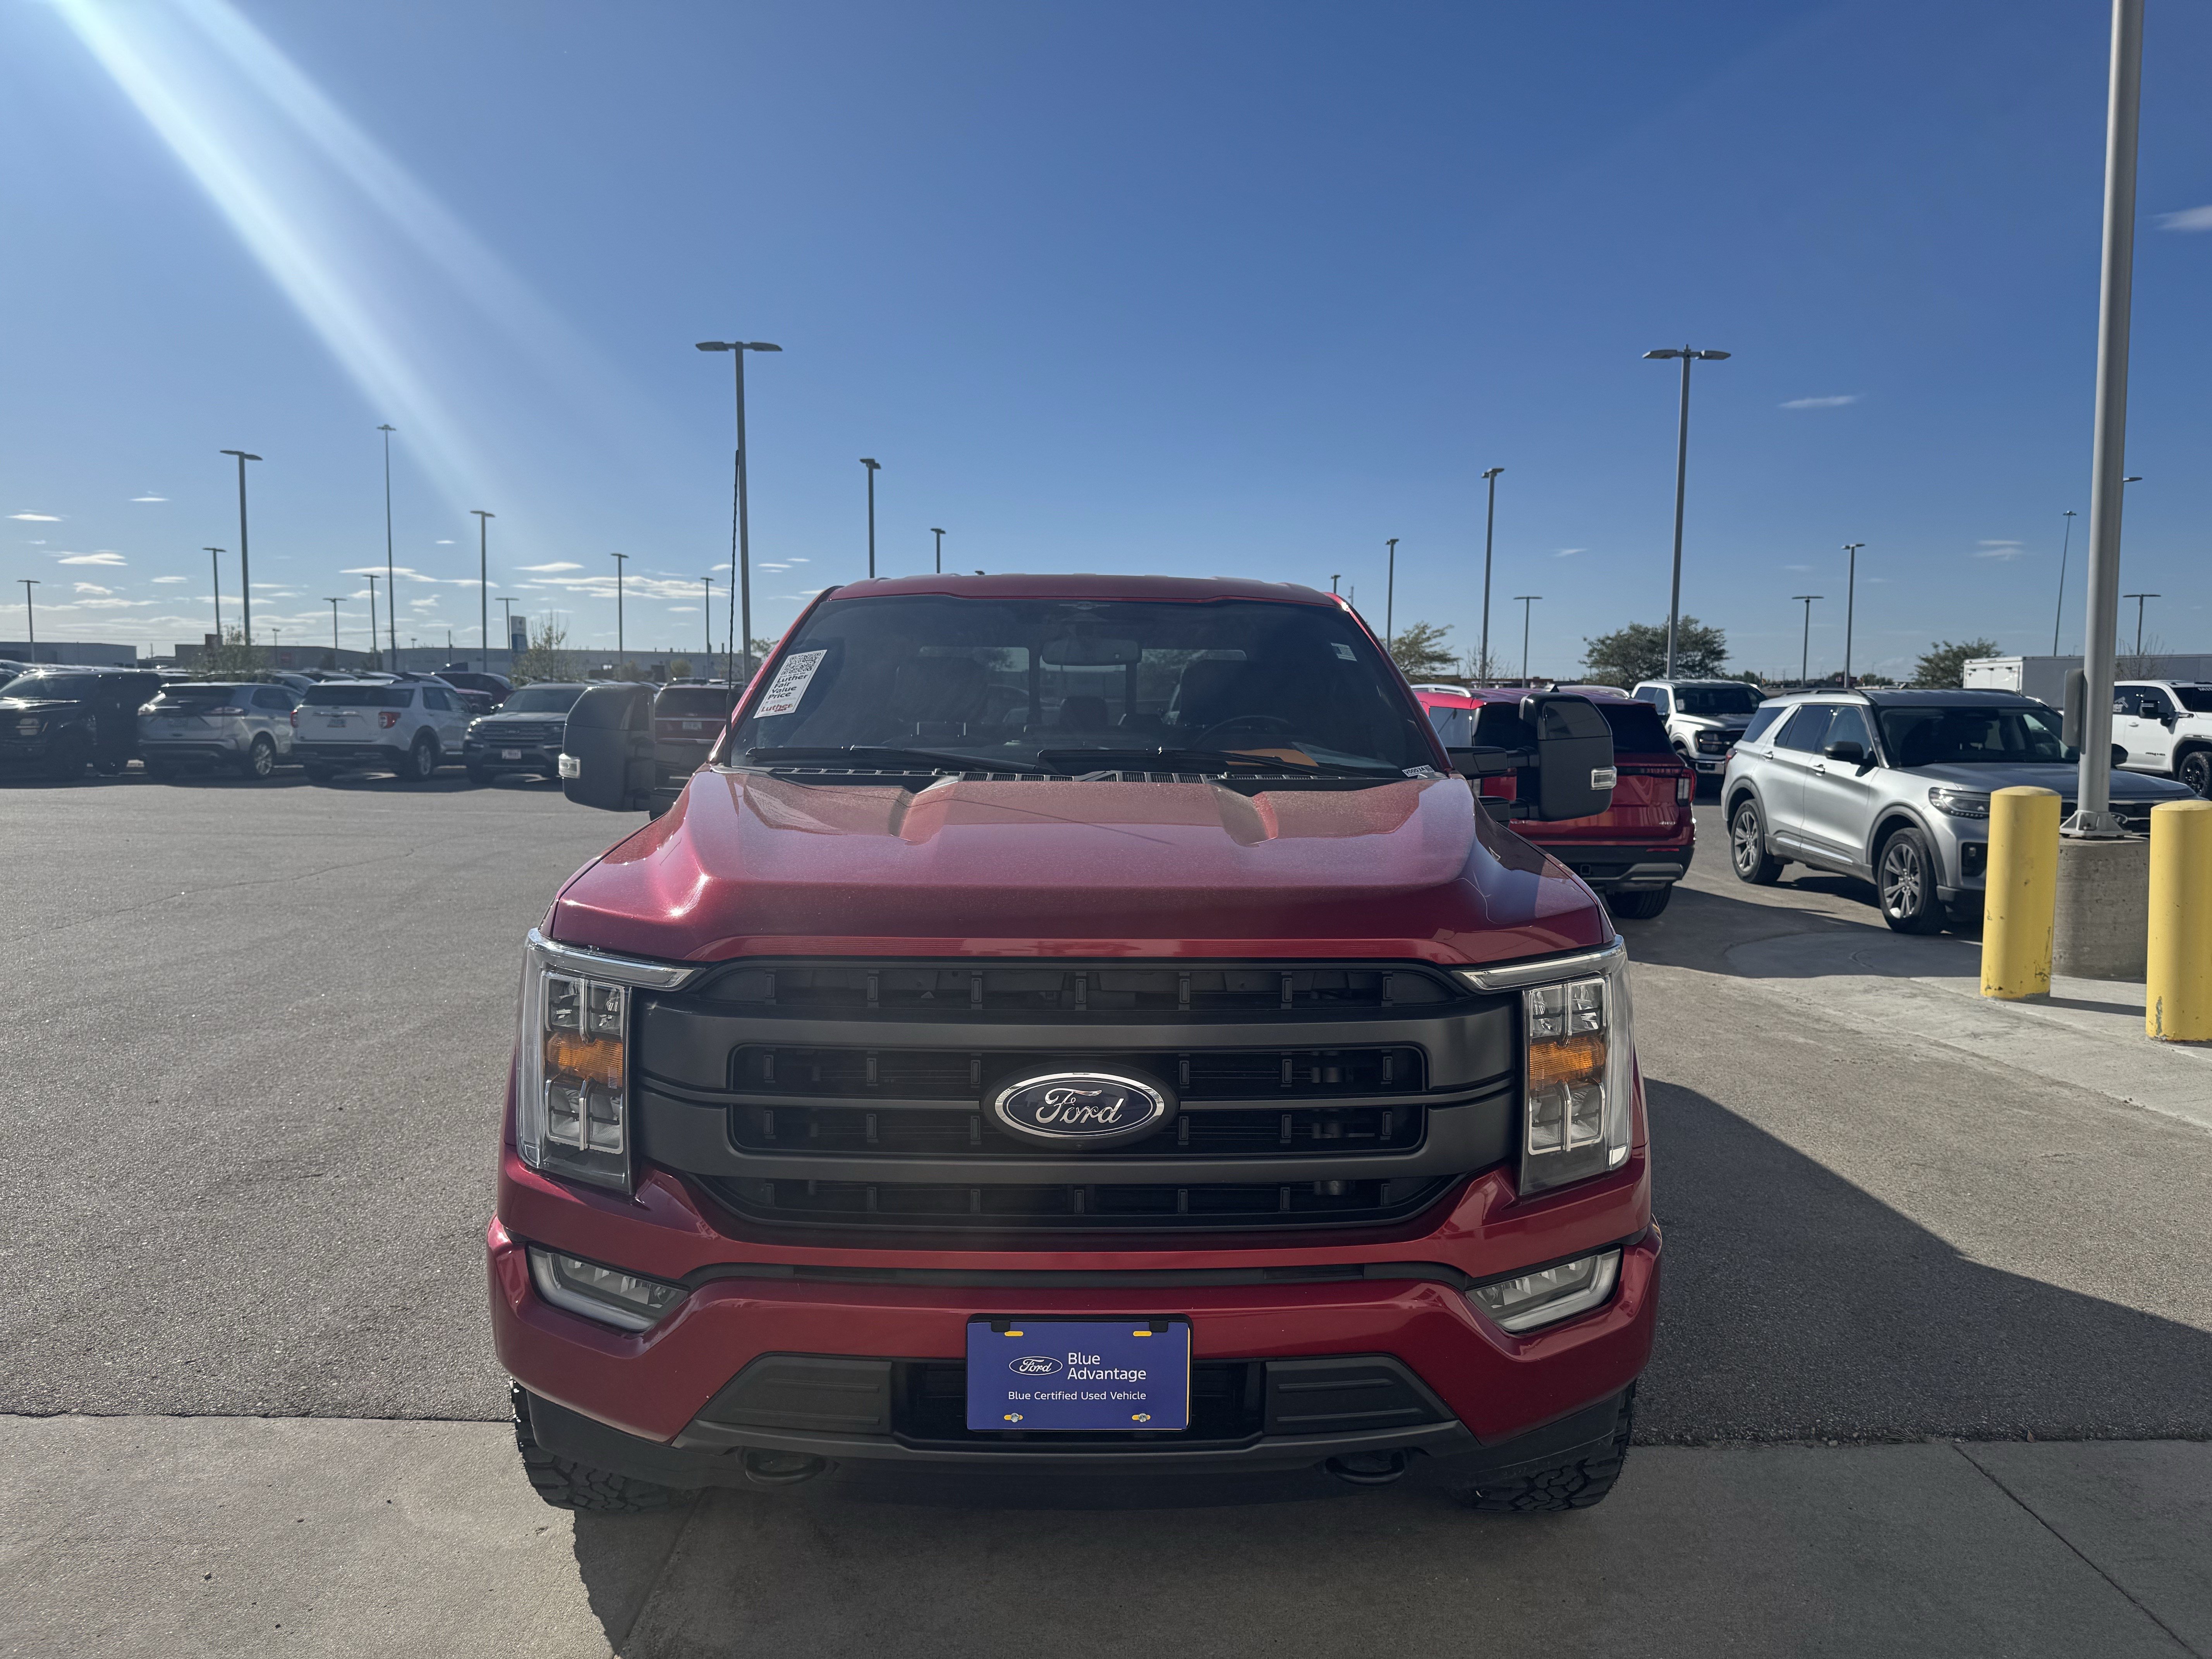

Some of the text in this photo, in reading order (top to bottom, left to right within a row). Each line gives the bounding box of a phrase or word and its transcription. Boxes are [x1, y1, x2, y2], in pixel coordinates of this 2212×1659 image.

[777, 674, 808, 683] Luther
[772, 686, 797, 694] Value
[768, 692, 792, 700] Price
[1036, 1088, 1124, 1124] Ford
[1068, 1352, 1101, 1365] Blue
[1019, 1358, 1053, 1372] Ford
[1067, 1368, 1146, 1382] Advantage
[1008, 1391, 1146, 1400] Blue Certified Used Vehicle
